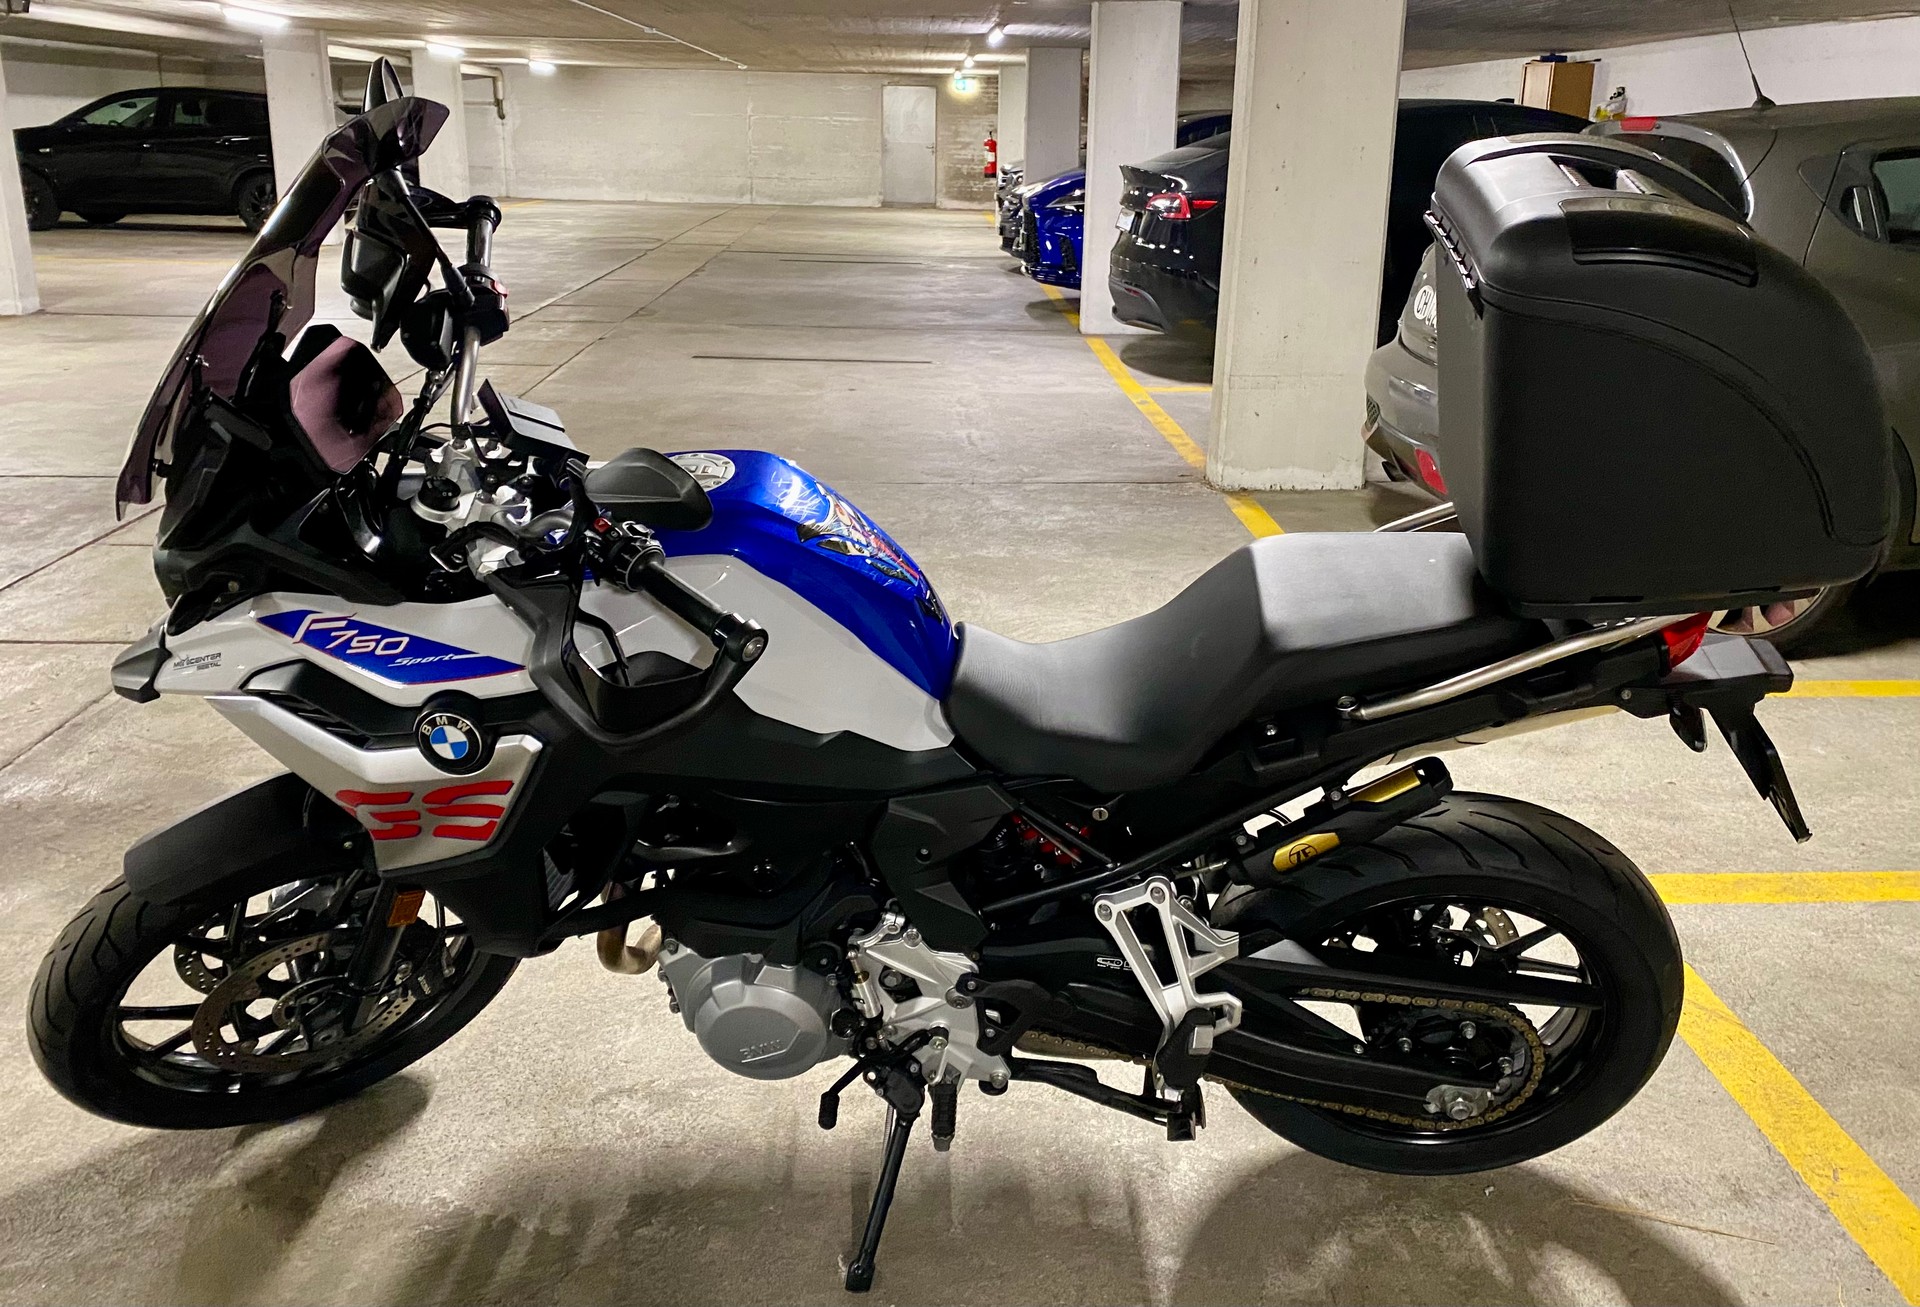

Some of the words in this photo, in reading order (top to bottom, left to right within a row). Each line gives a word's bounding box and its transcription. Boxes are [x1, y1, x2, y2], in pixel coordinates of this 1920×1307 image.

[388, 653, 464, 667] Sport
[421, 716, 470, 736] BMW
[336, 780, 514, 841] GS
